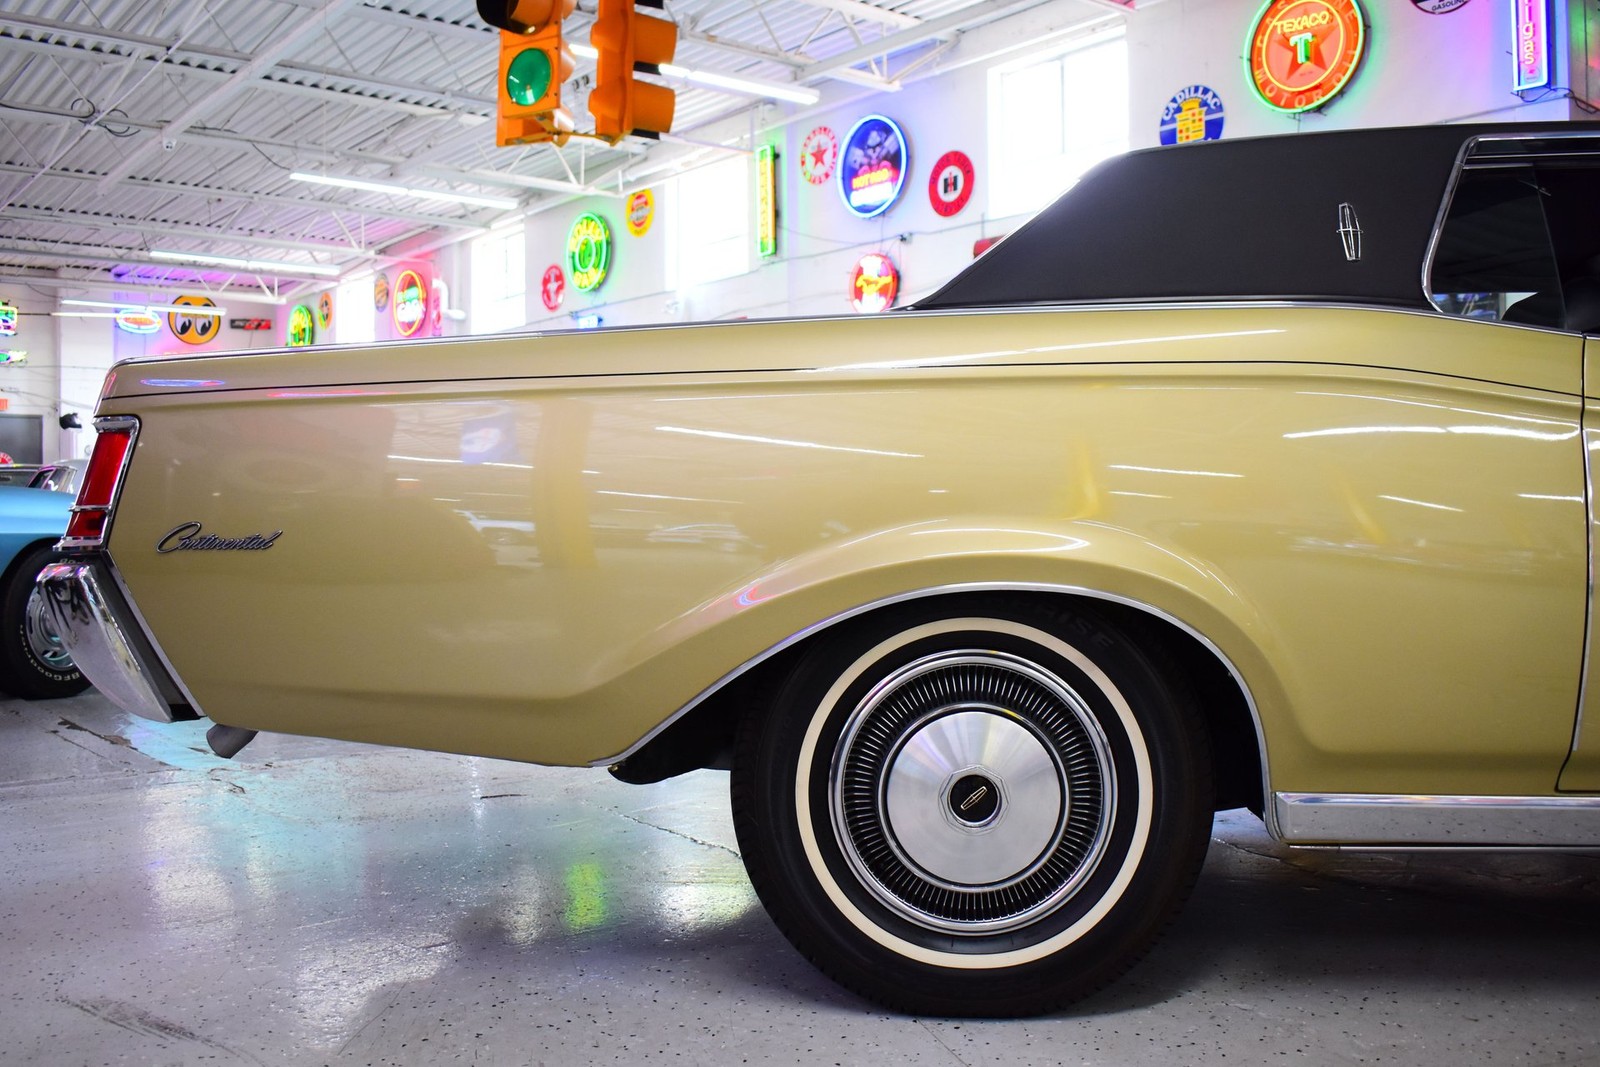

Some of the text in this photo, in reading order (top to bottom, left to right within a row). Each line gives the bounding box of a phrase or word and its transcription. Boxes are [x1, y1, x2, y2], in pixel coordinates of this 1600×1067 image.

[1275, 10, 1330, 34] TEXACO
[1163, 86, 1221, 121] CADILLAC
[1254, 67, 1324, 108] MOTOR
[156, 521, 283, 553] Continental
